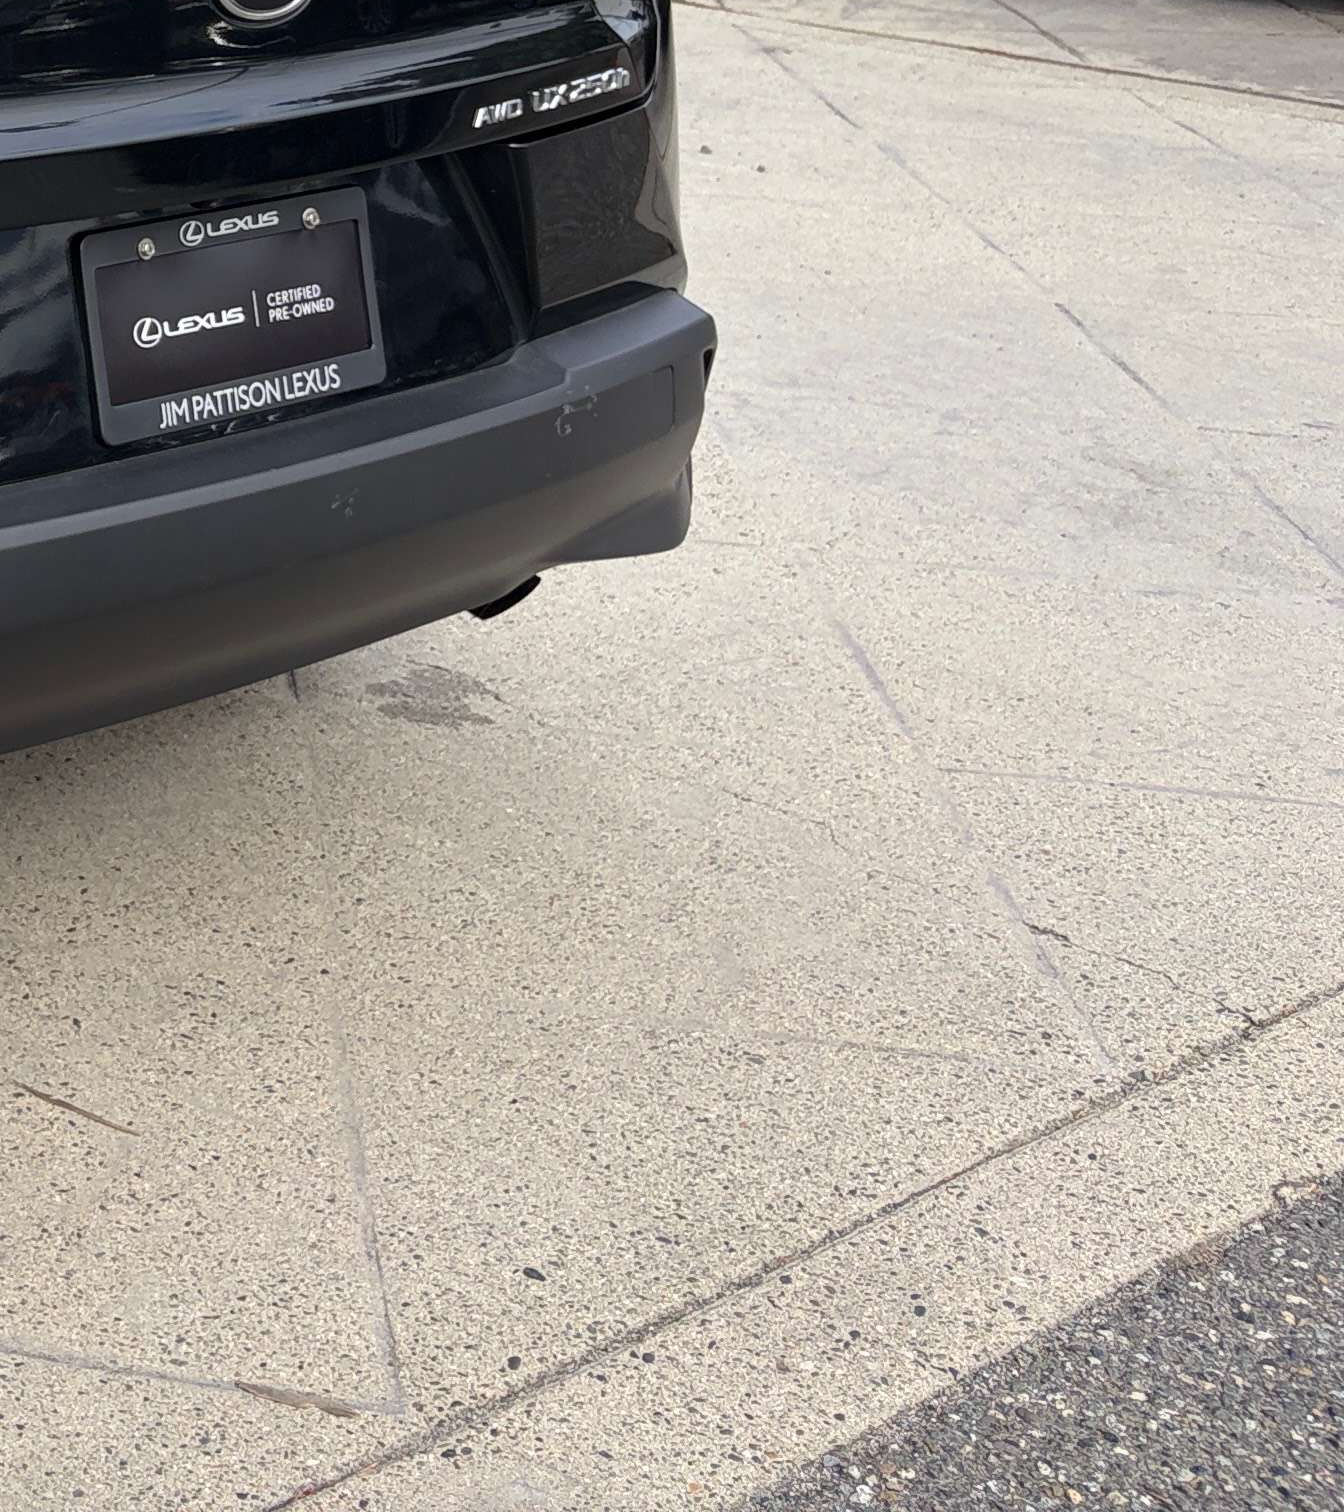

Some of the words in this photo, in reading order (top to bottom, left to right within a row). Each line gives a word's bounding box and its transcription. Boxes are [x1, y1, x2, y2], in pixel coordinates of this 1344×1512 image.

[472, 98, 523, 128] AWD
[207, 210, 279, 237] LEXUS
[266, 284, 322, 307] CERTIFIED
[163, 306, 246, 337] LEXUS
[268, 297, 335, 323] PRE-OWNED
[159, 398, 190, 429] JIM
[191, 377, 282, 421] PATTISON
[282, 364, 341, 400] LEXUS
